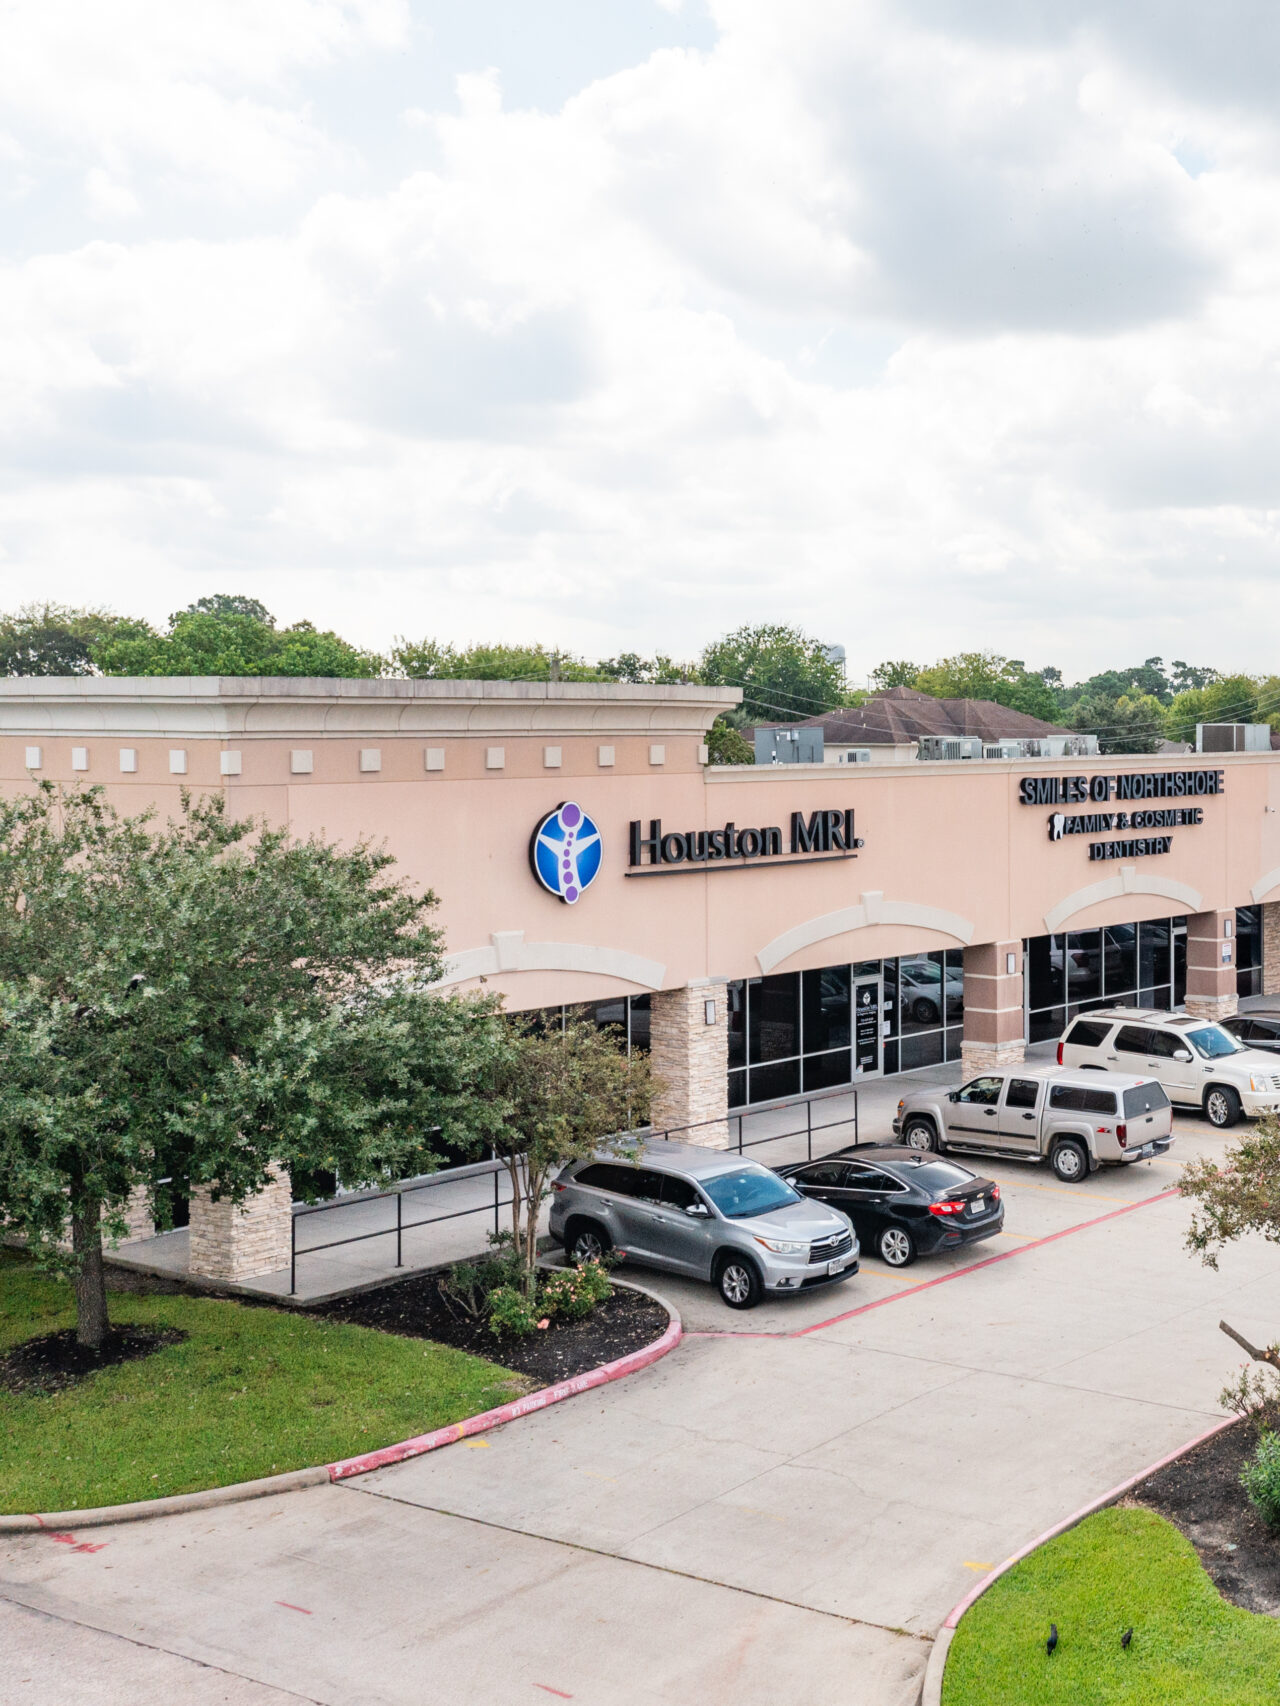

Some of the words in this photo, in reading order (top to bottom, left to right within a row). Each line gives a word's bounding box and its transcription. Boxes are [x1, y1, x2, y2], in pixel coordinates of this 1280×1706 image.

[1020, 776, 1087, 805] SMILES
[1090, 776, 1116, 801] OF
[1117, 770, 1224, 800] NORTHSHORE
[1064, 813, 1115, 835] FAMILY
[1117, 812, 1130, 830] &
[1131, 808, 1204, 829] COSMETIC
[629, 819, 783, 867] Houston
[1089, 836, 1174, 861] DENTISTRY
